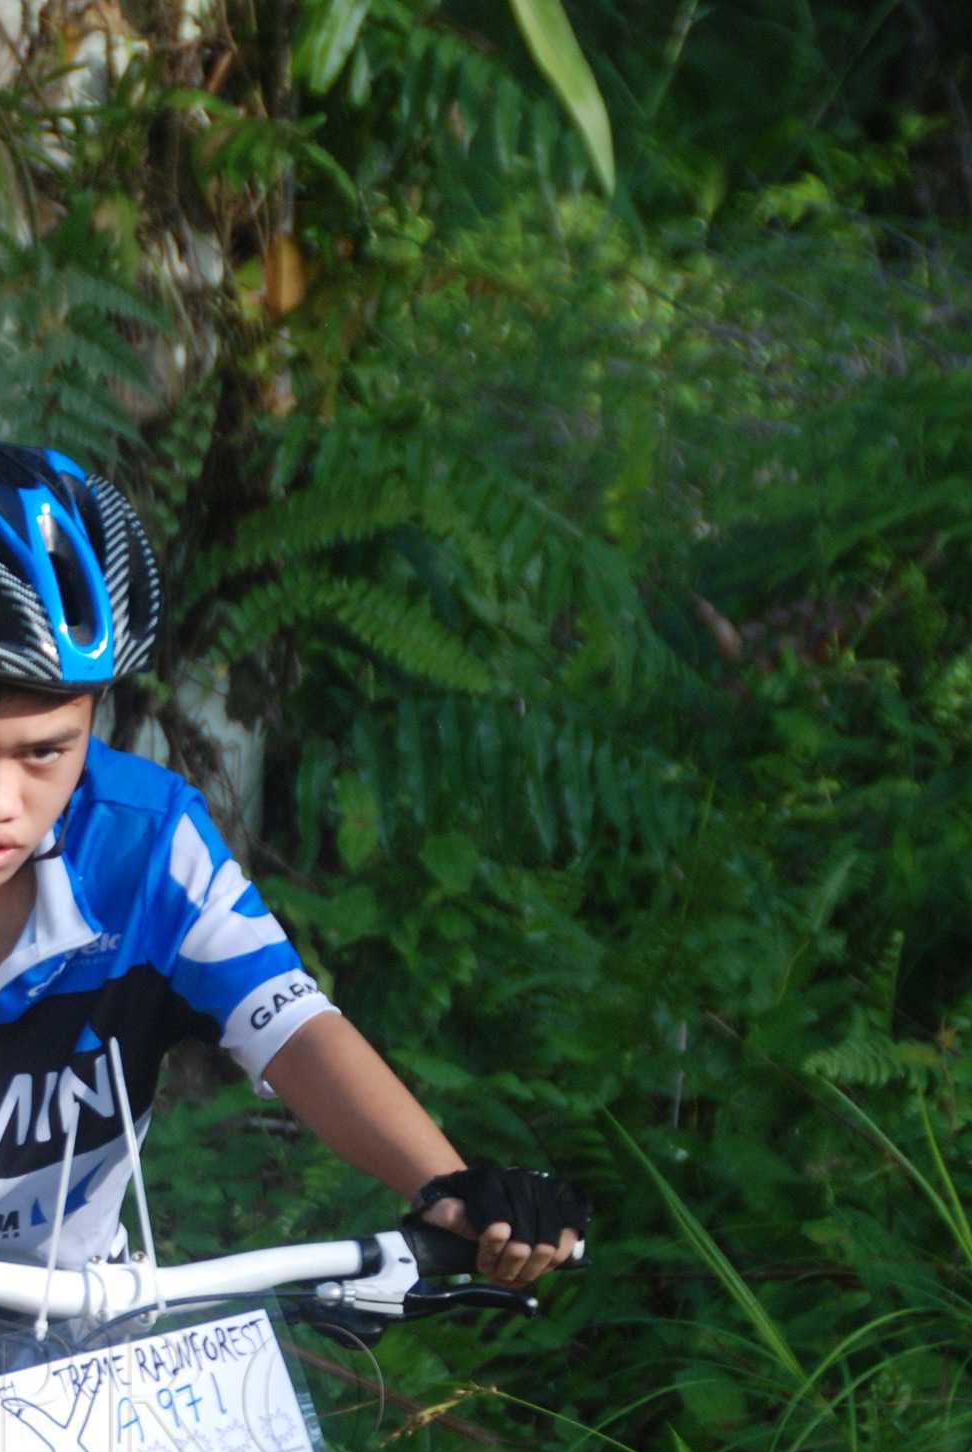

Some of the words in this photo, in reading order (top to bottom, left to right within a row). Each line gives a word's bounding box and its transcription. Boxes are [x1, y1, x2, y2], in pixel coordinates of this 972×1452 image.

[133, 1317, 268, 1383] RAINFOREST
[116, 1396, 145, 1445] A
[156, 1371, 227, 1429] 971
